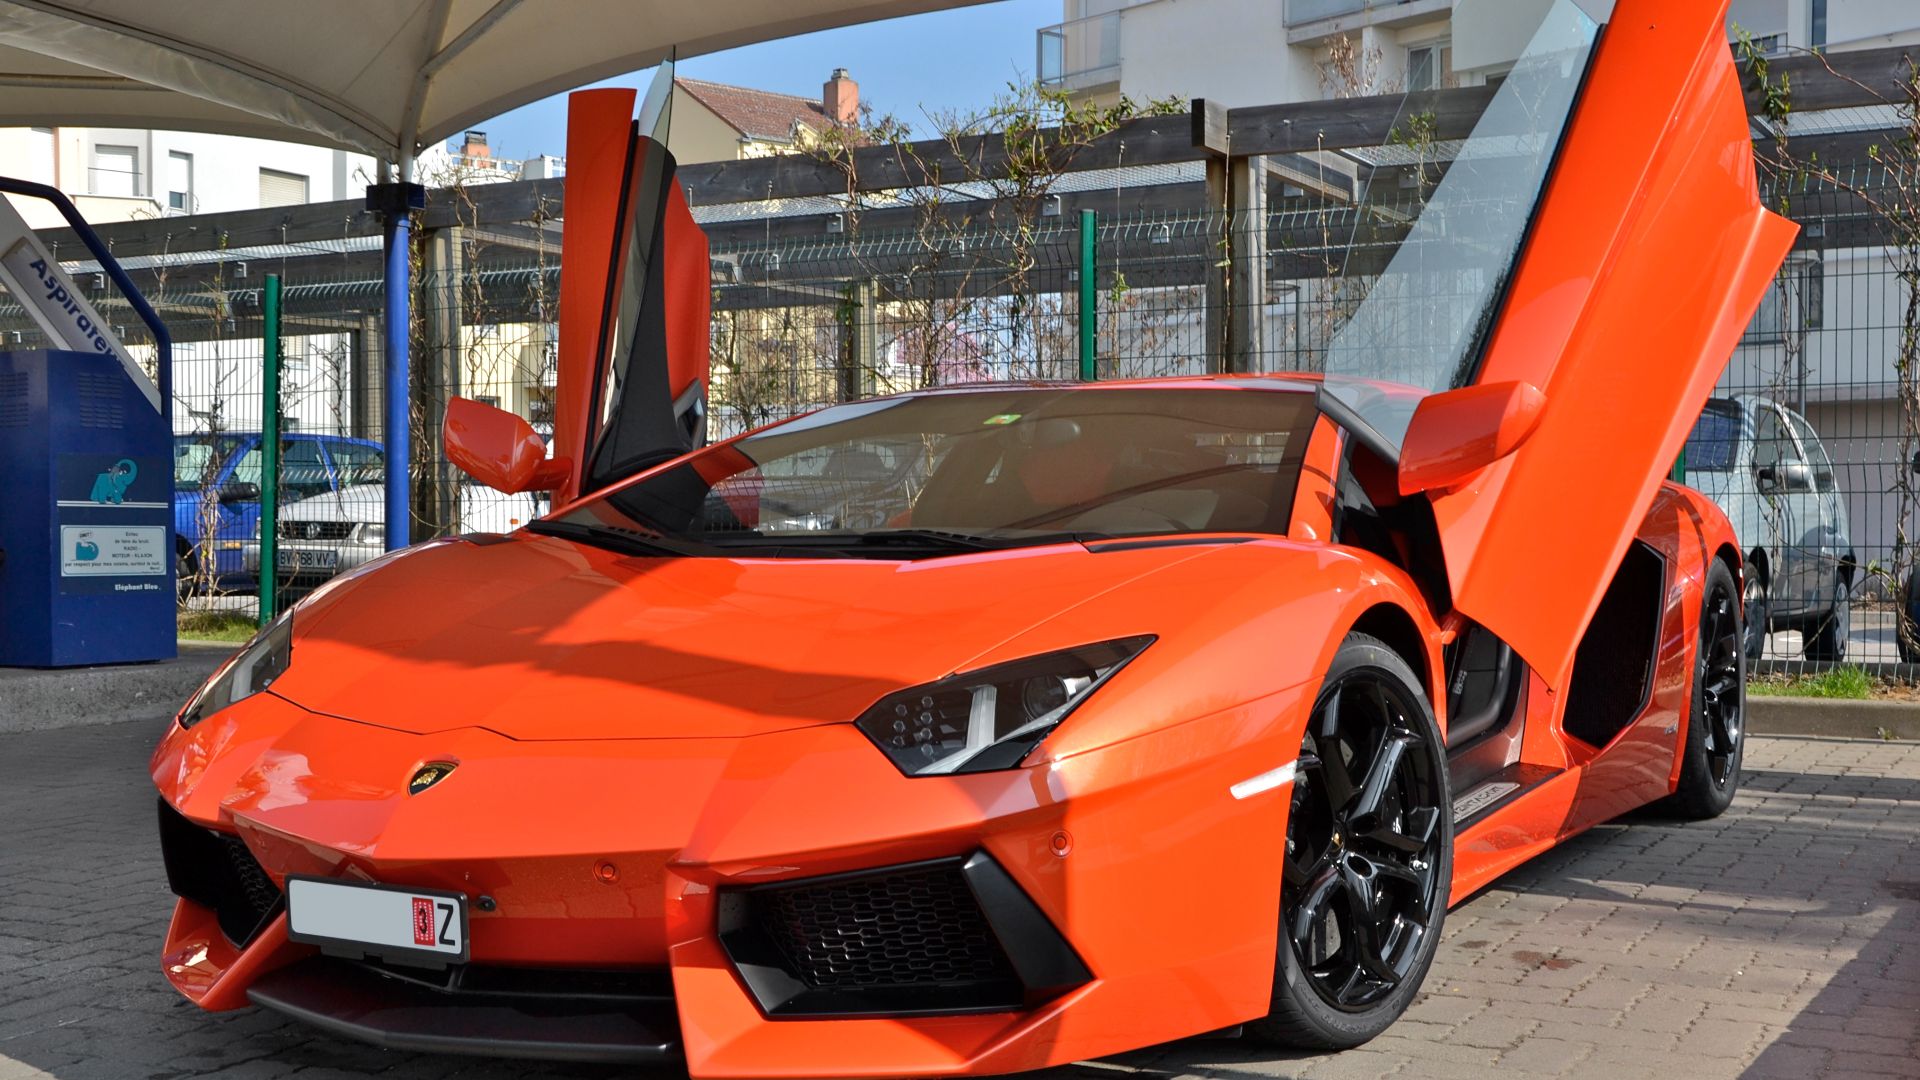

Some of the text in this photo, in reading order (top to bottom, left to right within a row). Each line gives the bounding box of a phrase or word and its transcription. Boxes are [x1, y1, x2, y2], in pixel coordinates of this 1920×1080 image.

[30, 259, 123, 366] Aspirate
[293, 552, 312, 566] 68
[437, 903, 456, 946] Z
